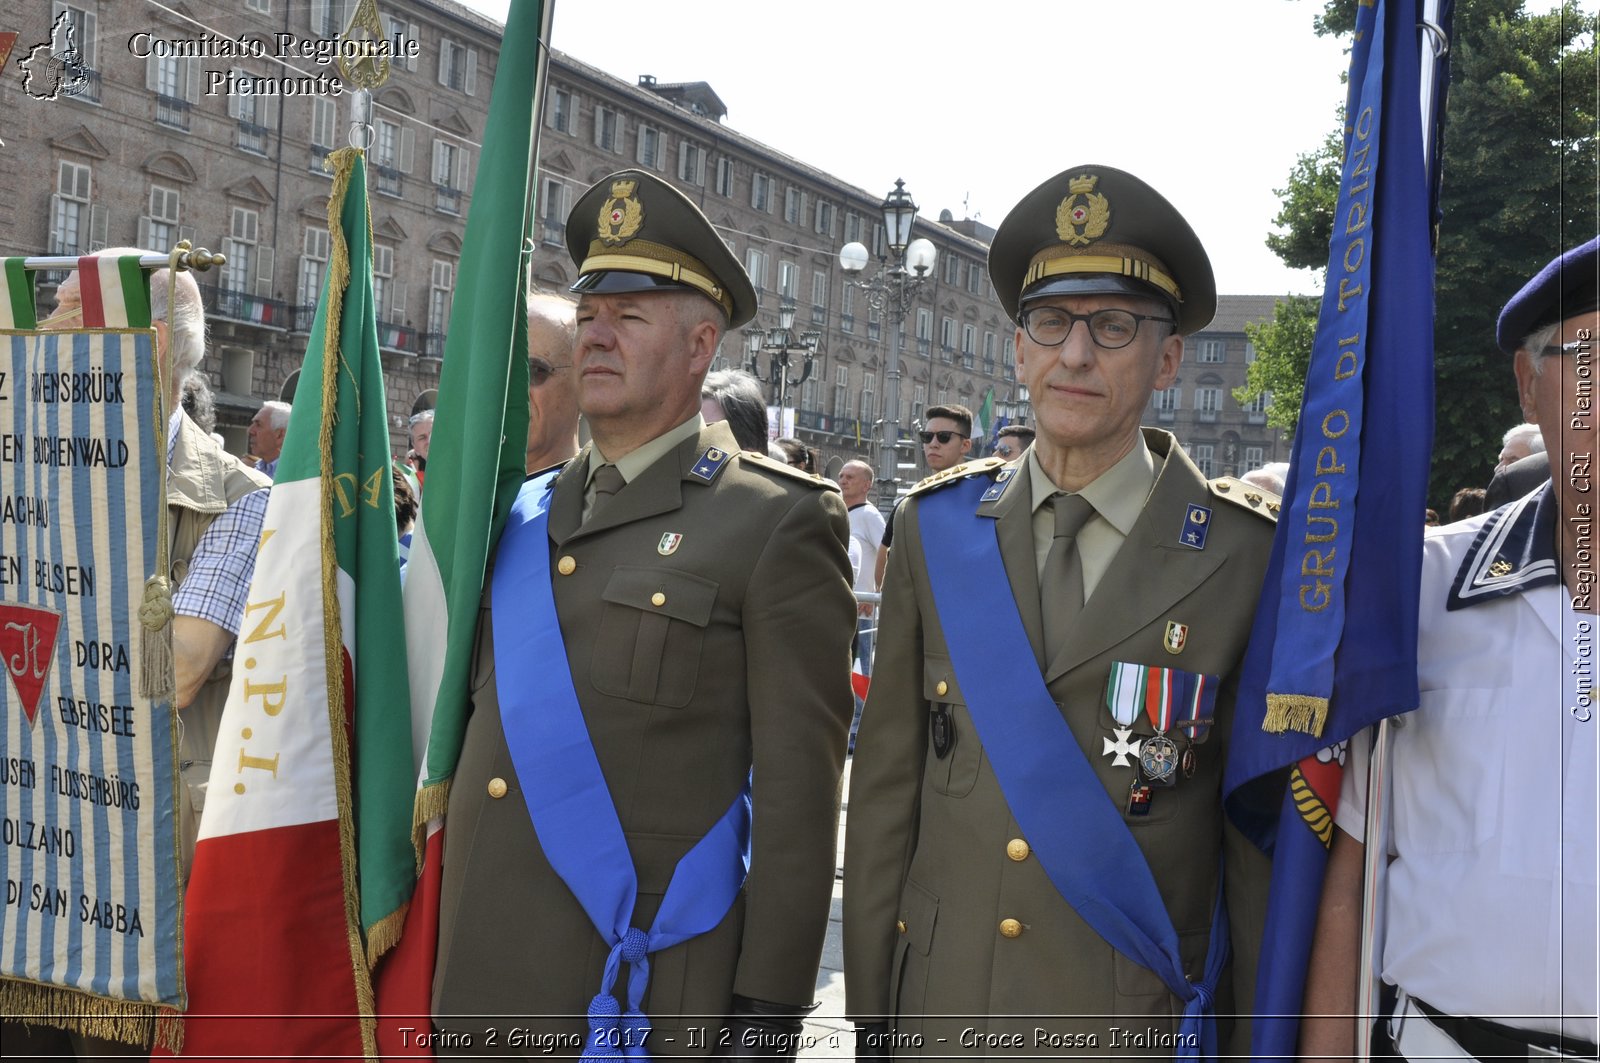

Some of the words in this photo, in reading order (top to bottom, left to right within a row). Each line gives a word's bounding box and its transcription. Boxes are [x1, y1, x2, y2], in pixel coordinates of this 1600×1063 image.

[1338, 105, 1374, 313] TORINO
[1335, 332, 1360, 381] DI
[33, 436, 129, 468] BUCHENWALD
[0, 495, 49, 528] ACHAU
[1298, 408, 1351, 614] GRUPPO
[35, 559, 94, 597] BELSEN
[76, 640, 131, 675] DORA
[58, 696, 136, 738] EBENSEE
[0, 757, 36, 789] USEN
[51, 764, 140, 812] FLOSSENBÜRG
[2, 818, 75, 858] OLZANO
[7, 879, 23, 908] DI
[30, 883, 67, 918] SAN
[79, 894, 144, 937] SABBA
